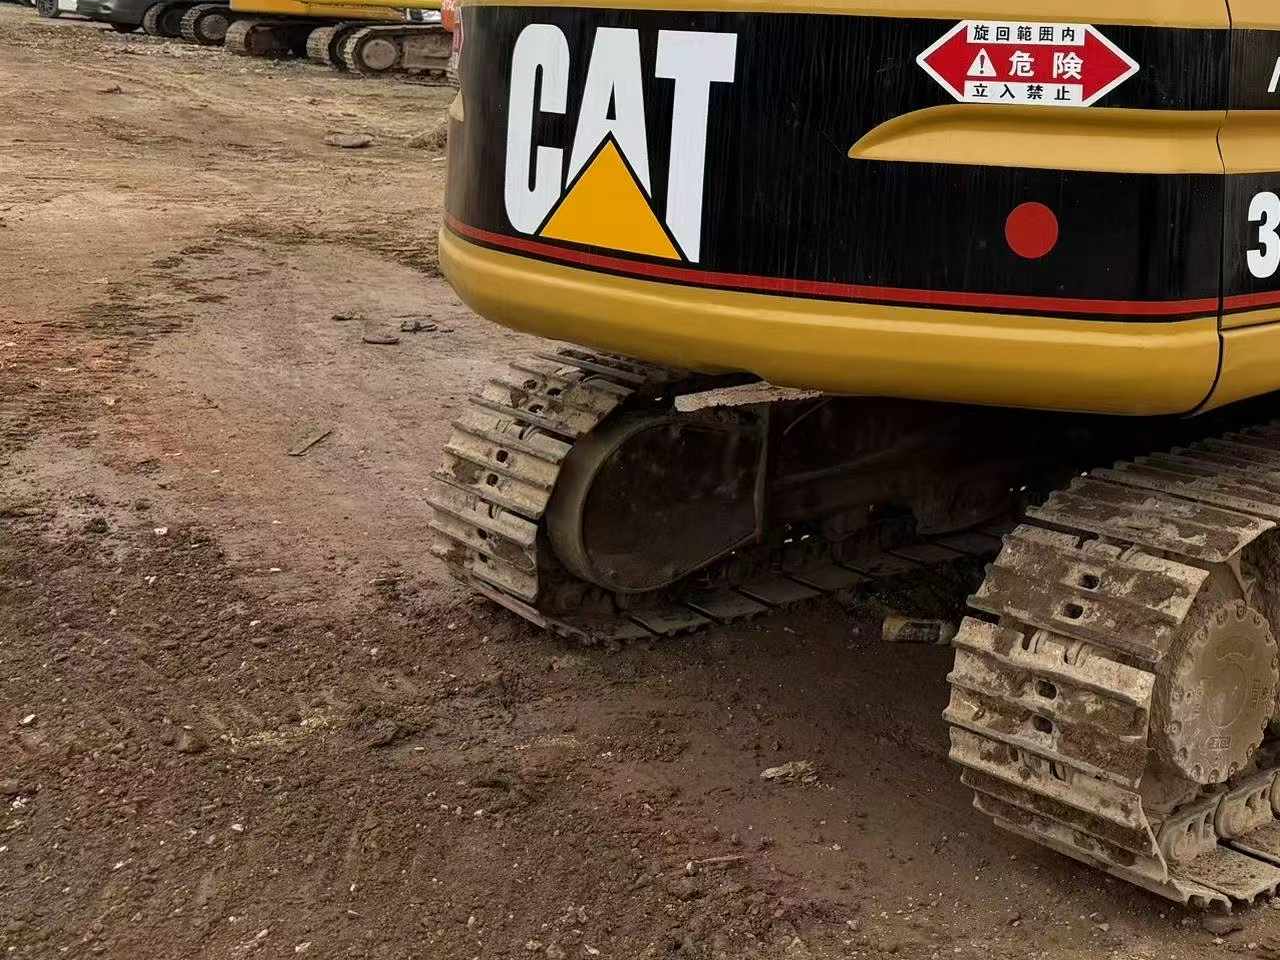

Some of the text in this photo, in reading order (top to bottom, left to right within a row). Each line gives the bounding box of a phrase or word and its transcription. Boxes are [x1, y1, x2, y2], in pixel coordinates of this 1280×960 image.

[973, 24, 1076, 42] 旋回範囲内
[1008, 50, 1084, 80] 危険
[972, 83, 1071, 101] 立入禁止
[503, 23, 738, 264] CAT
